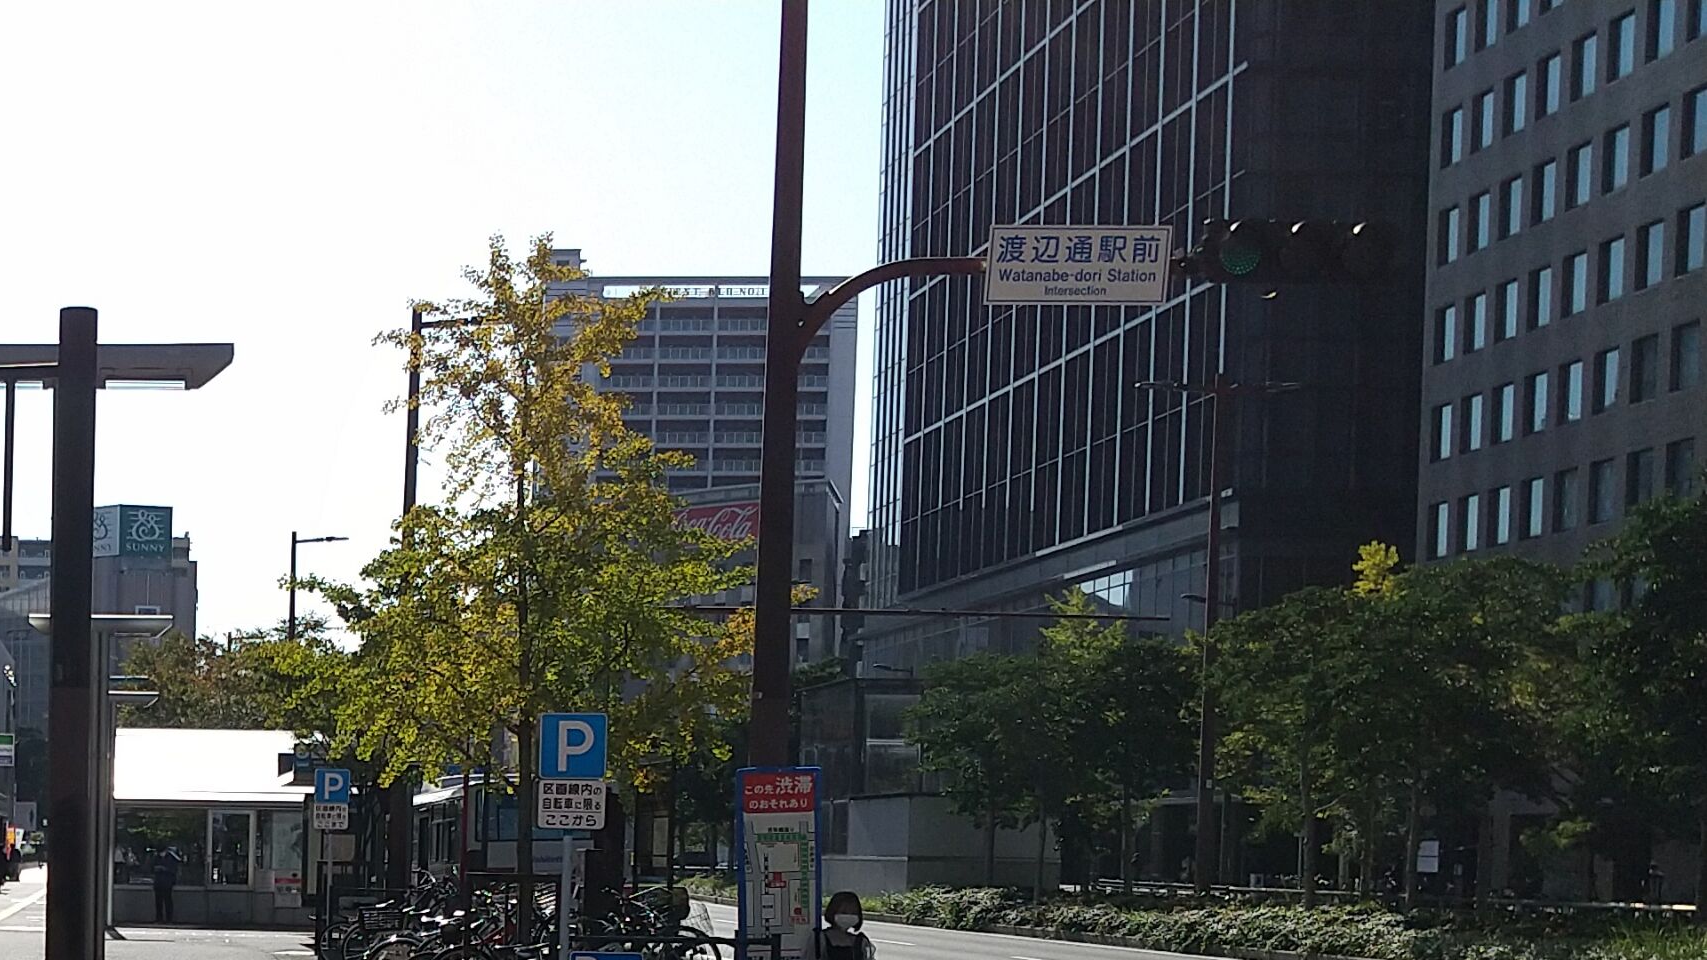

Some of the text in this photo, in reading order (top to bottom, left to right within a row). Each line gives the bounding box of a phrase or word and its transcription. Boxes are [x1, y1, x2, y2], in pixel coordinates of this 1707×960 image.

[996, 235, 1161, 264] 渡辺通駅前
[999, 268, 1156, 282] Watanabe-dori Station
[1044, 286, 1107, 296] Intersection
[125, 542, 166, 553] SUNNY
[557, 720, 595, 772] P
[323, 772, 344, 800] P
[749, 798, 808, 809] のおそれあり
[545, 814, 597, 827] ここから
